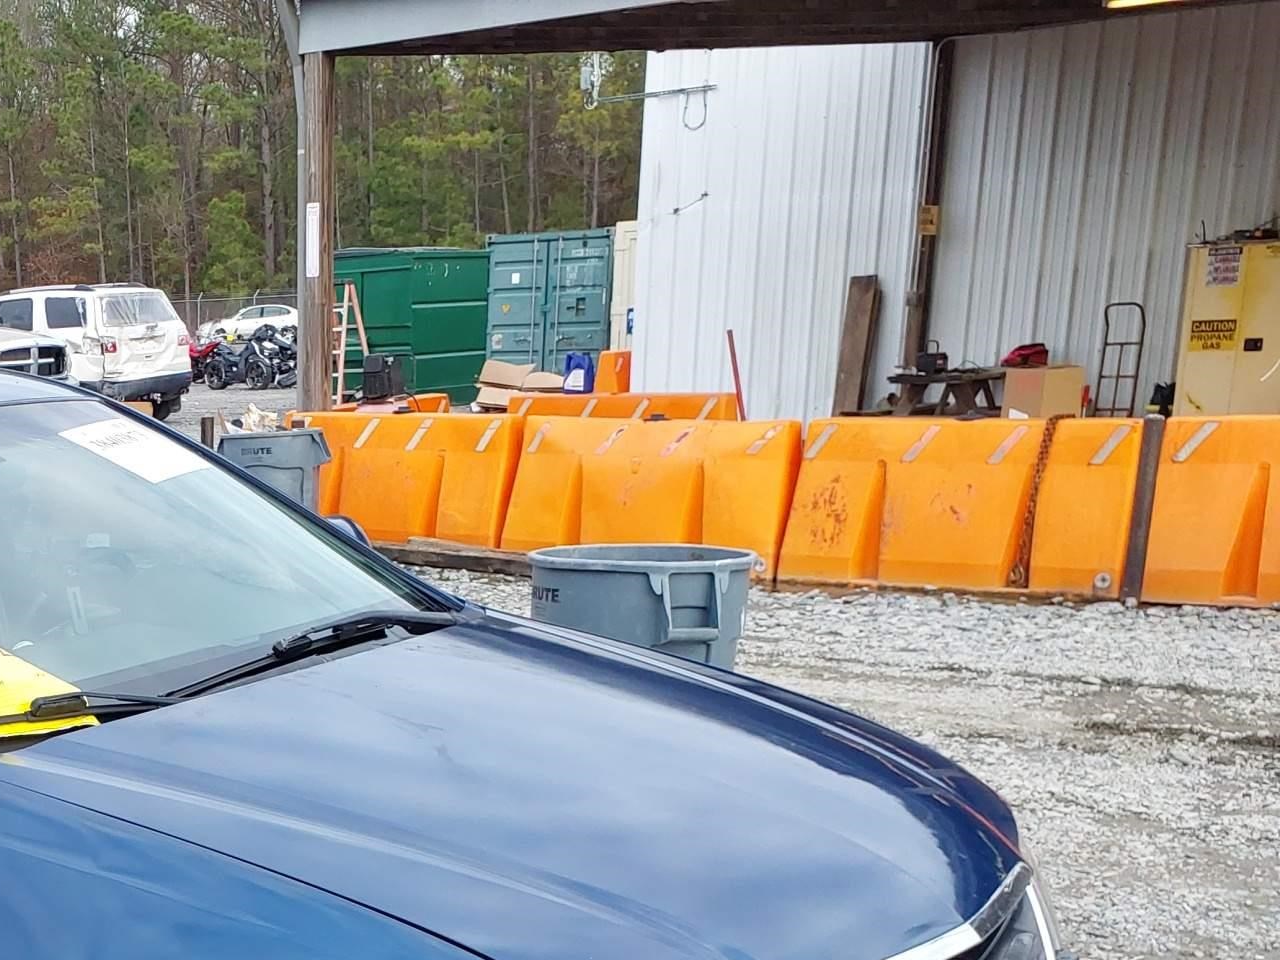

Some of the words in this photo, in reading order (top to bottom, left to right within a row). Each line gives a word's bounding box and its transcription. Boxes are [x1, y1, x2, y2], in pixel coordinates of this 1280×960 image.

[1193, 321, 1235, 331] CAUTION
[1191, 333, 1234, 342] PROPANE
[1202, 341, 1221, 350] GAS
